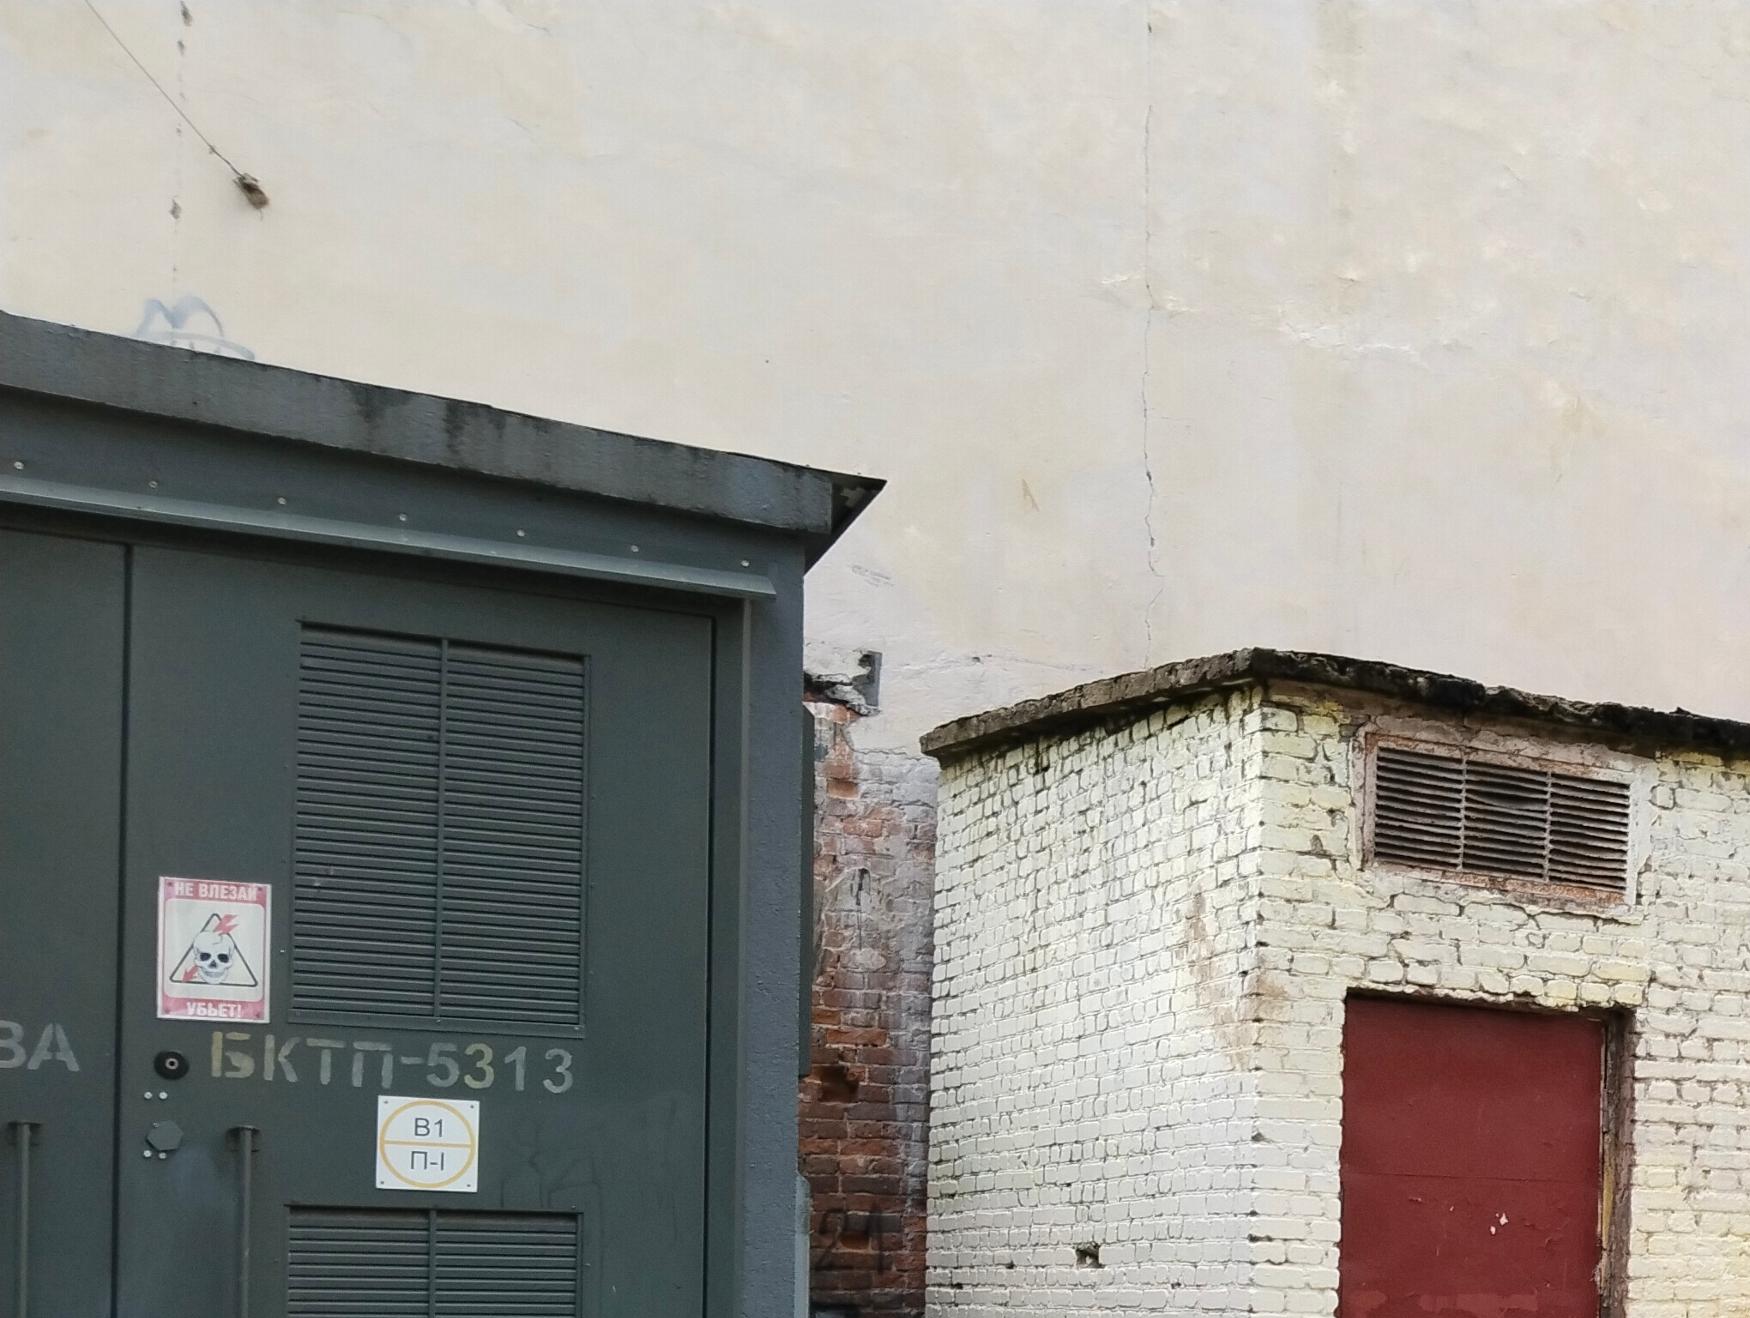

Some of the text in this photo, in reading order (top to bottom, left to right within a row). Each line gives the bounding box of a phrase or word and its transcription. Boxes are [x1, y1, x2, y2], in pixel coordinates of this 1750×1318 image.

[174, 882, 257, 901] НЕ ВЛЕЗАЙ
[186, 1002, 241, 1018] УБЬЕТ!
[211, 1031, 574, 1093] БКТП-5313
[414, 1117, 443, 1138] В1
